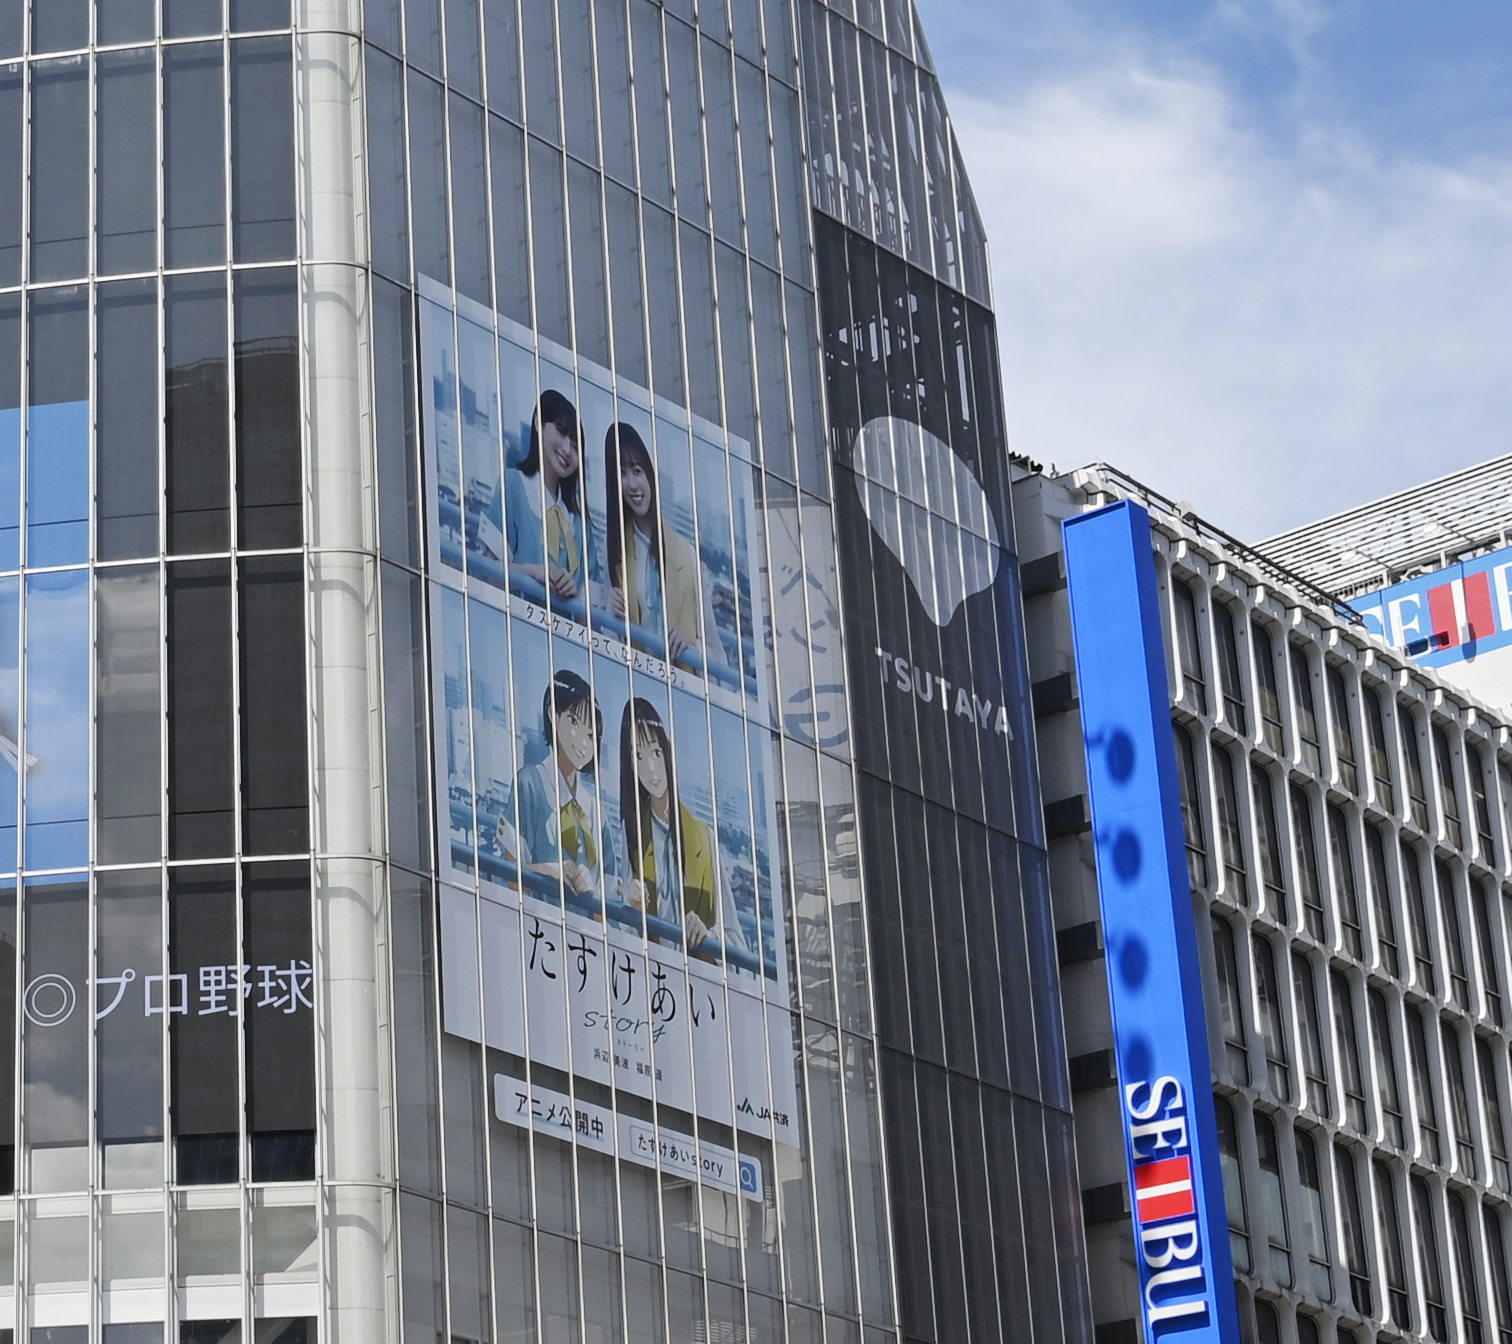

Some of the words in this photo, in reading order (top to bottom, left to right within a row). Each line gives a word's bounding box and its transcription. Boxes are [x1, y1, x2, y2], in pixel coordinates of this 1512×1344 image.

[877, 646, 1016, 741] TSUTAYA
[529, 919, 716, 1027] たすけあい
[584, 1010, 667, 1044] story
[514, 1091, 604, 1140] アニメ公開中
[1124, 1075, 1207, 1344] SEIBU
